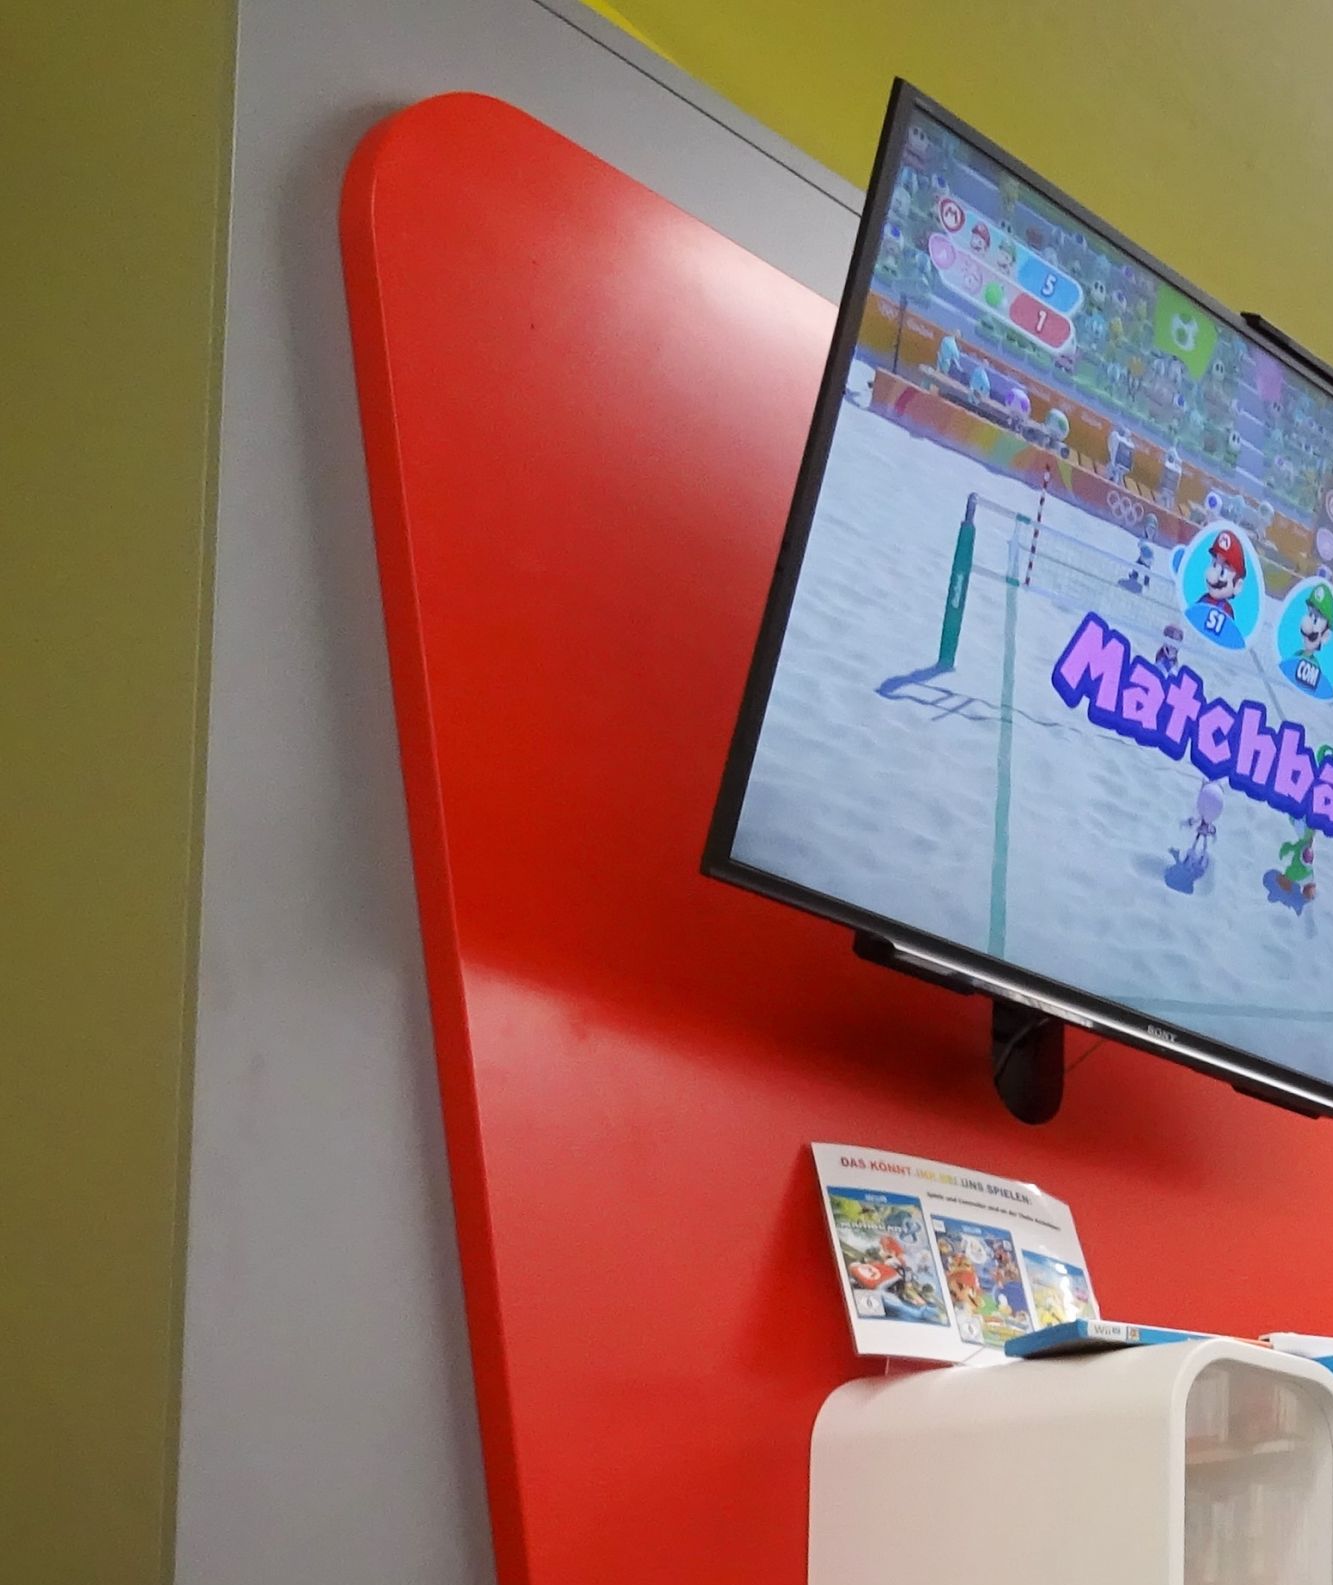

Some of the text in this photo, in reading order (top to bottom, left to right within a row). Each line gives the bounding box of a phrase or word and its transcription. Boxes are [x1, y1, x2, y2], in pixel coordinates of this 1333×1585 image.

[1043, 274, 1058, 297] 5
[1035, 309, 1047, 333] 1
[1205, 609, 1225, 634] S1
[1295, 661, 1320, 689] COM
[1147, 1023, 1178, 1044] SONY
[840, 1156, 866, 1169] DAS
[961, 1177, 984, 1192] UNS
[1094, 1324, 1111, 1335] Wii
